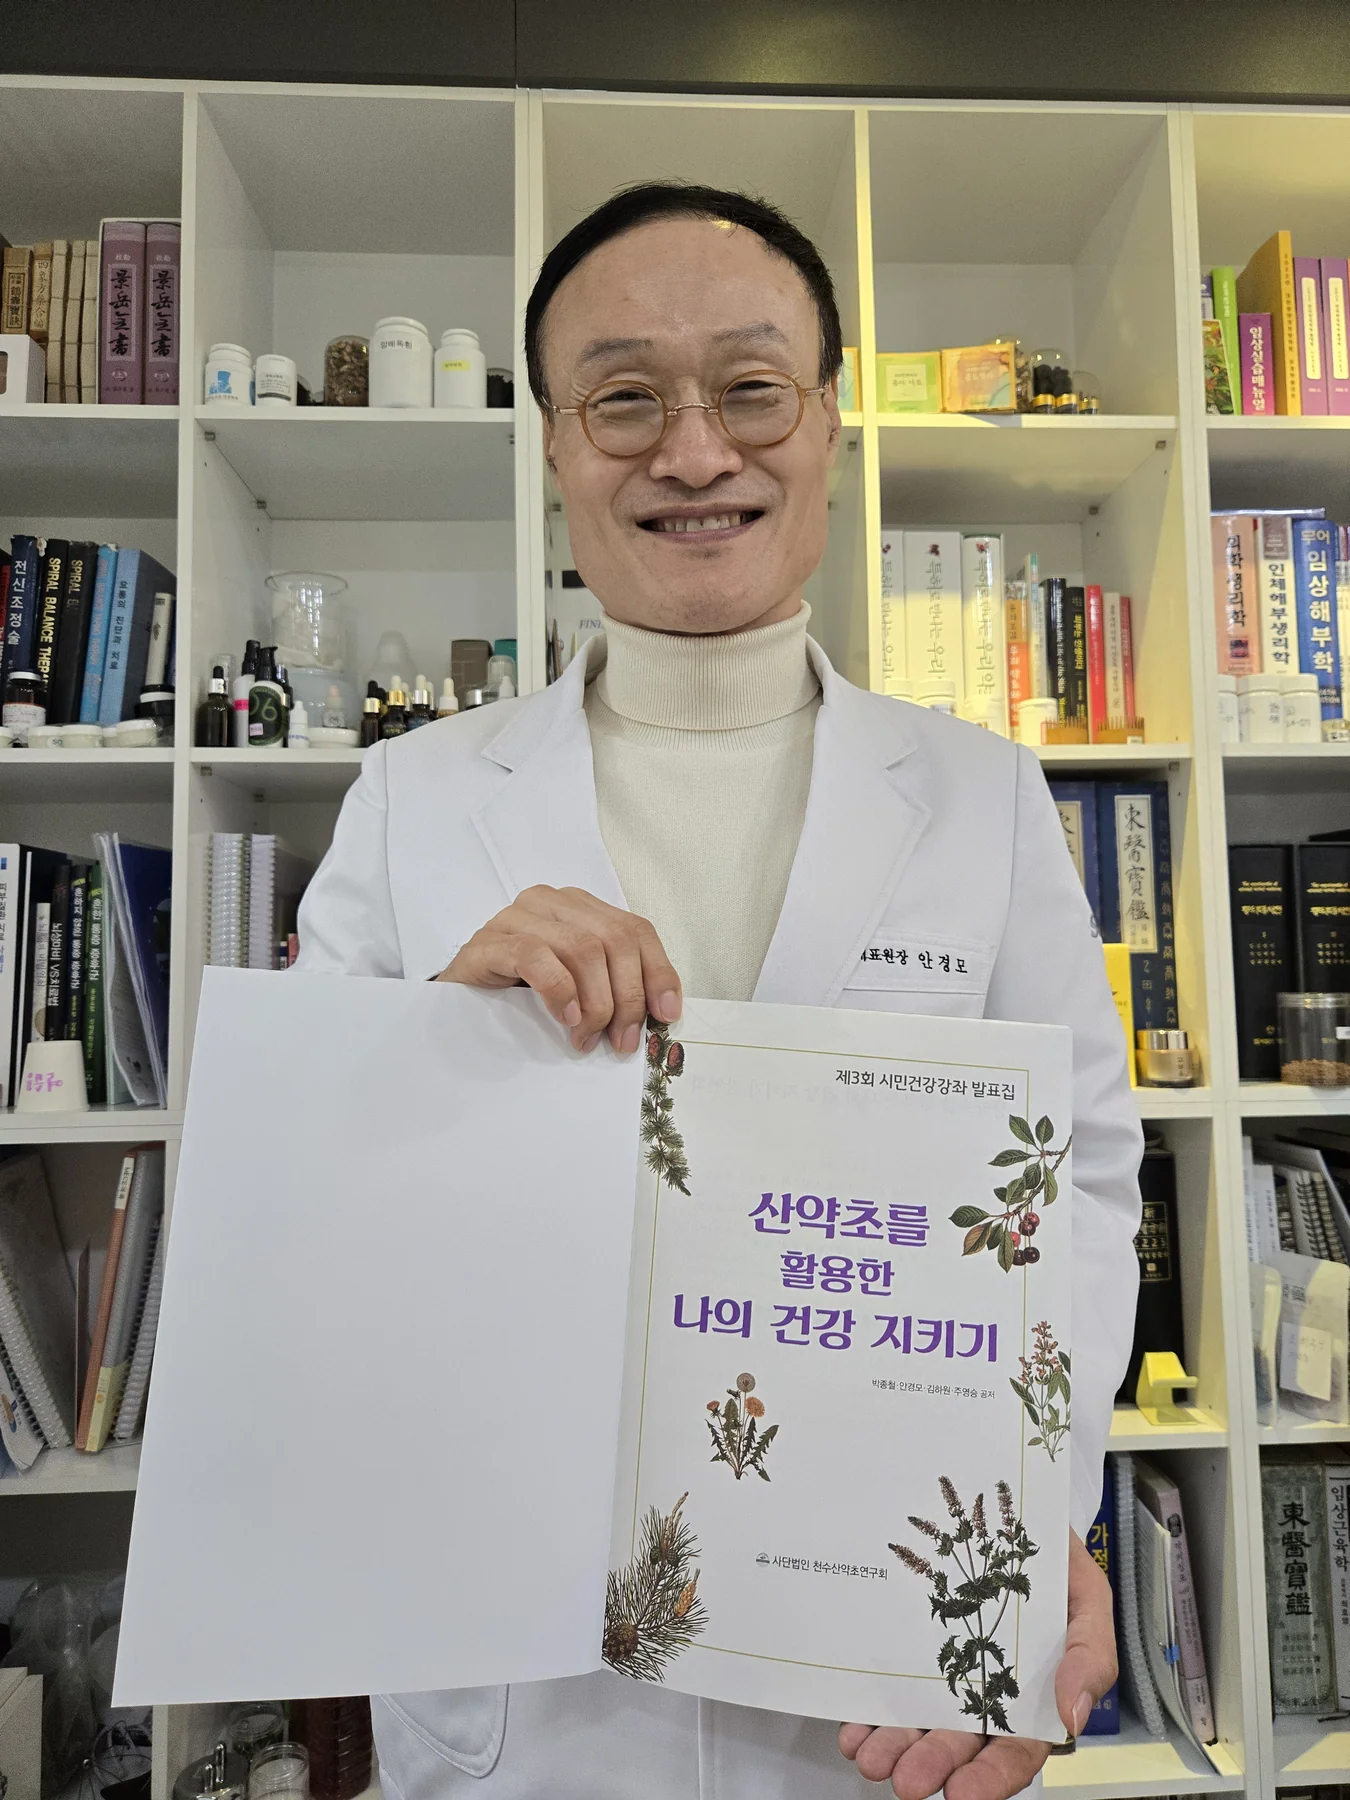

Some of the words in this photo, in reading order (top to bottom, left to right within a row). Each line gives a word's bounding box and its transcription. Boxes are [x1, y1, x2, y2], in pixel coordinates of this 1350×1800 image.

[1301, 529, 1331, 545] 무어
[46, 557, 61, 593] SPIRAL
[68, 559, 83, 595] SPIRAL
[925, 561, 943, 601] 특허로
[7, 560, 27, 645] 전신조정술
[40, 596, 58, 643] BALANCE
[929, 603, 943, 639] 만나는
[1307, 550, 1335, 674] 임상해부학
[51, 922, 63, 961] 뇌성마비
[48, 963, 60, 1006] VS치료법
[835, 1069, 875, 1087] 제3회
[879, 1073, 968, 1096] 시민건강강좌
[972, 1081, 1015, 1101] 발표집
[748, 1192, 930, 1247] 산약초를
[780, 1250, 895, 1296] 활용한
[673, 1294, 753, 1338] 나의
[770, 1305, 857, 1350] 건강
[870, 1315, 997, 1362] 지키기
[980, 1389, 995, 1399] 공저
[1330, 1485, 1348, 1573] 임상근육학
[772, 1555, 810, 1570] 사단법인
[812, 1560, 888, 1580] 천수산약초연구회
[1091, 1522, 1108, 1580] 가정
[1278, 1501, 1313, 1616] 東醫寶鑑
